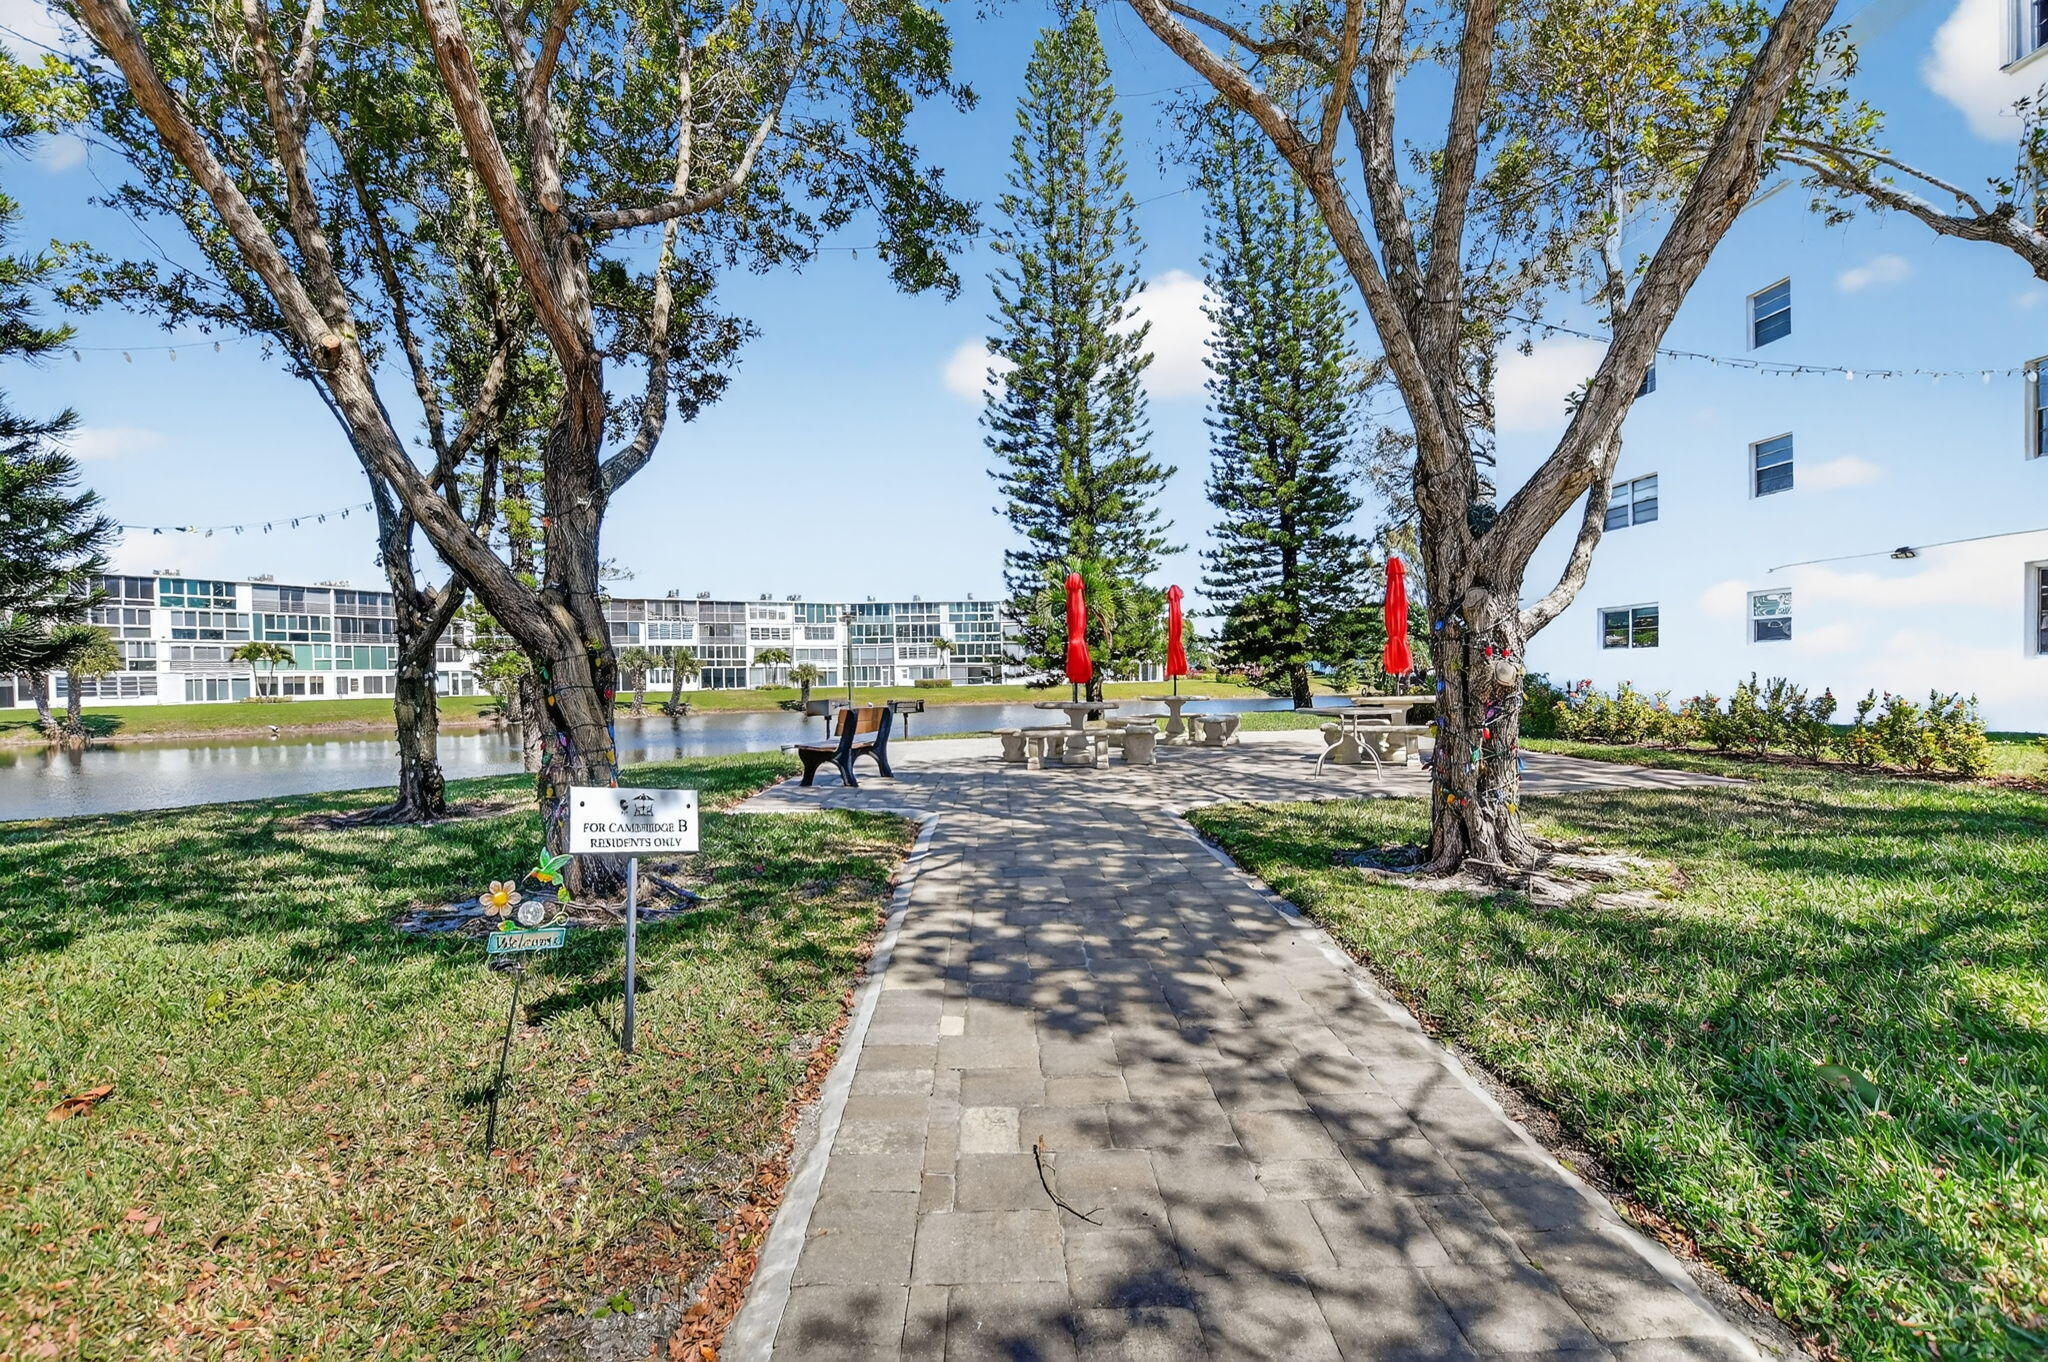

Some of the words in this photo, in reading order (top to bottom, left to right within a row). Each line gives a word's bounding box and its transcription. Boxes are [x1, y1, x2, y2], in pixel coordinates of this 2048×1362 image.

[583, 822, 606, 833] FOR
[678, 819, 688, 832] B
[590, 838, 651, 848] RESIDENTS
[654, 837, 683, 847] ONLY
[496, 933, 561, 949] Welcome
